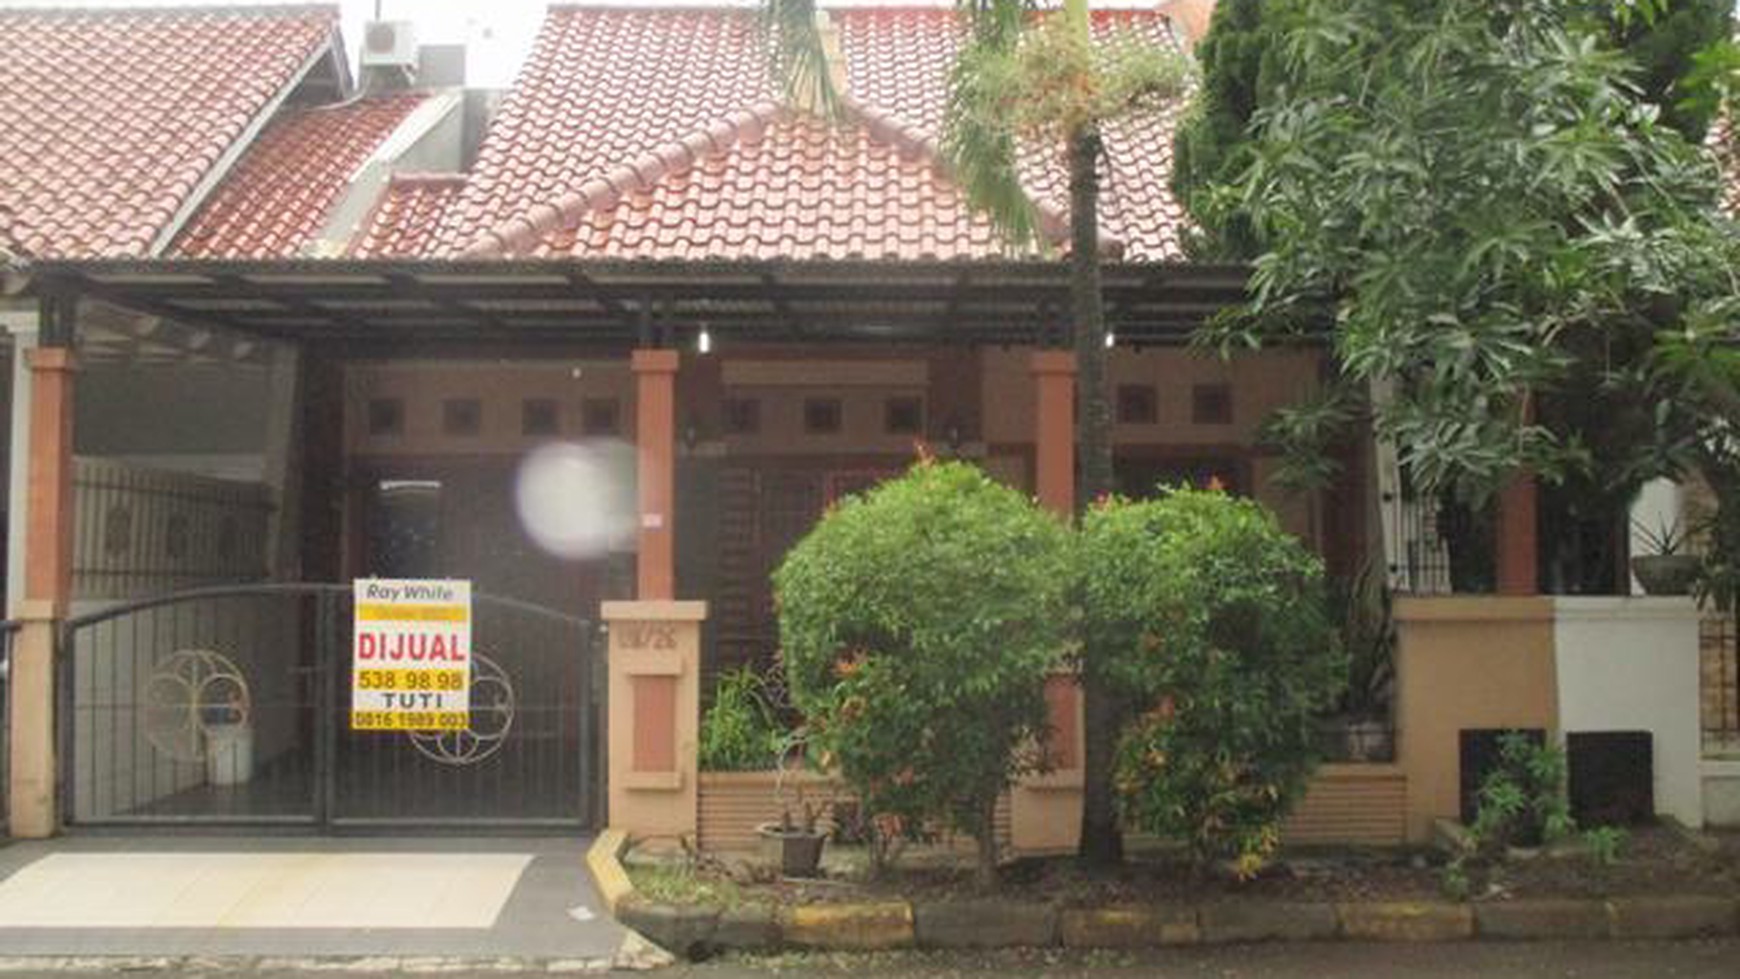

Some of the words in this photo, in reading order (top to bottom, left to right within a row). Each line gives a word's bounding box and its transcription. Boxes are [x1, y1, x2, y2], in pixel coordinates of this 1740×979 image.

[366, 584, 400, 601] Ray
[404, 585, 454, 599] White
[358, 632, 466, 661] DIJUAL
[359, 671, 396, 689] 538
[406, 671, 432, 689] 98
[437, 671, 463, 689] 98
[381, 693, 443, 708] TUTI
